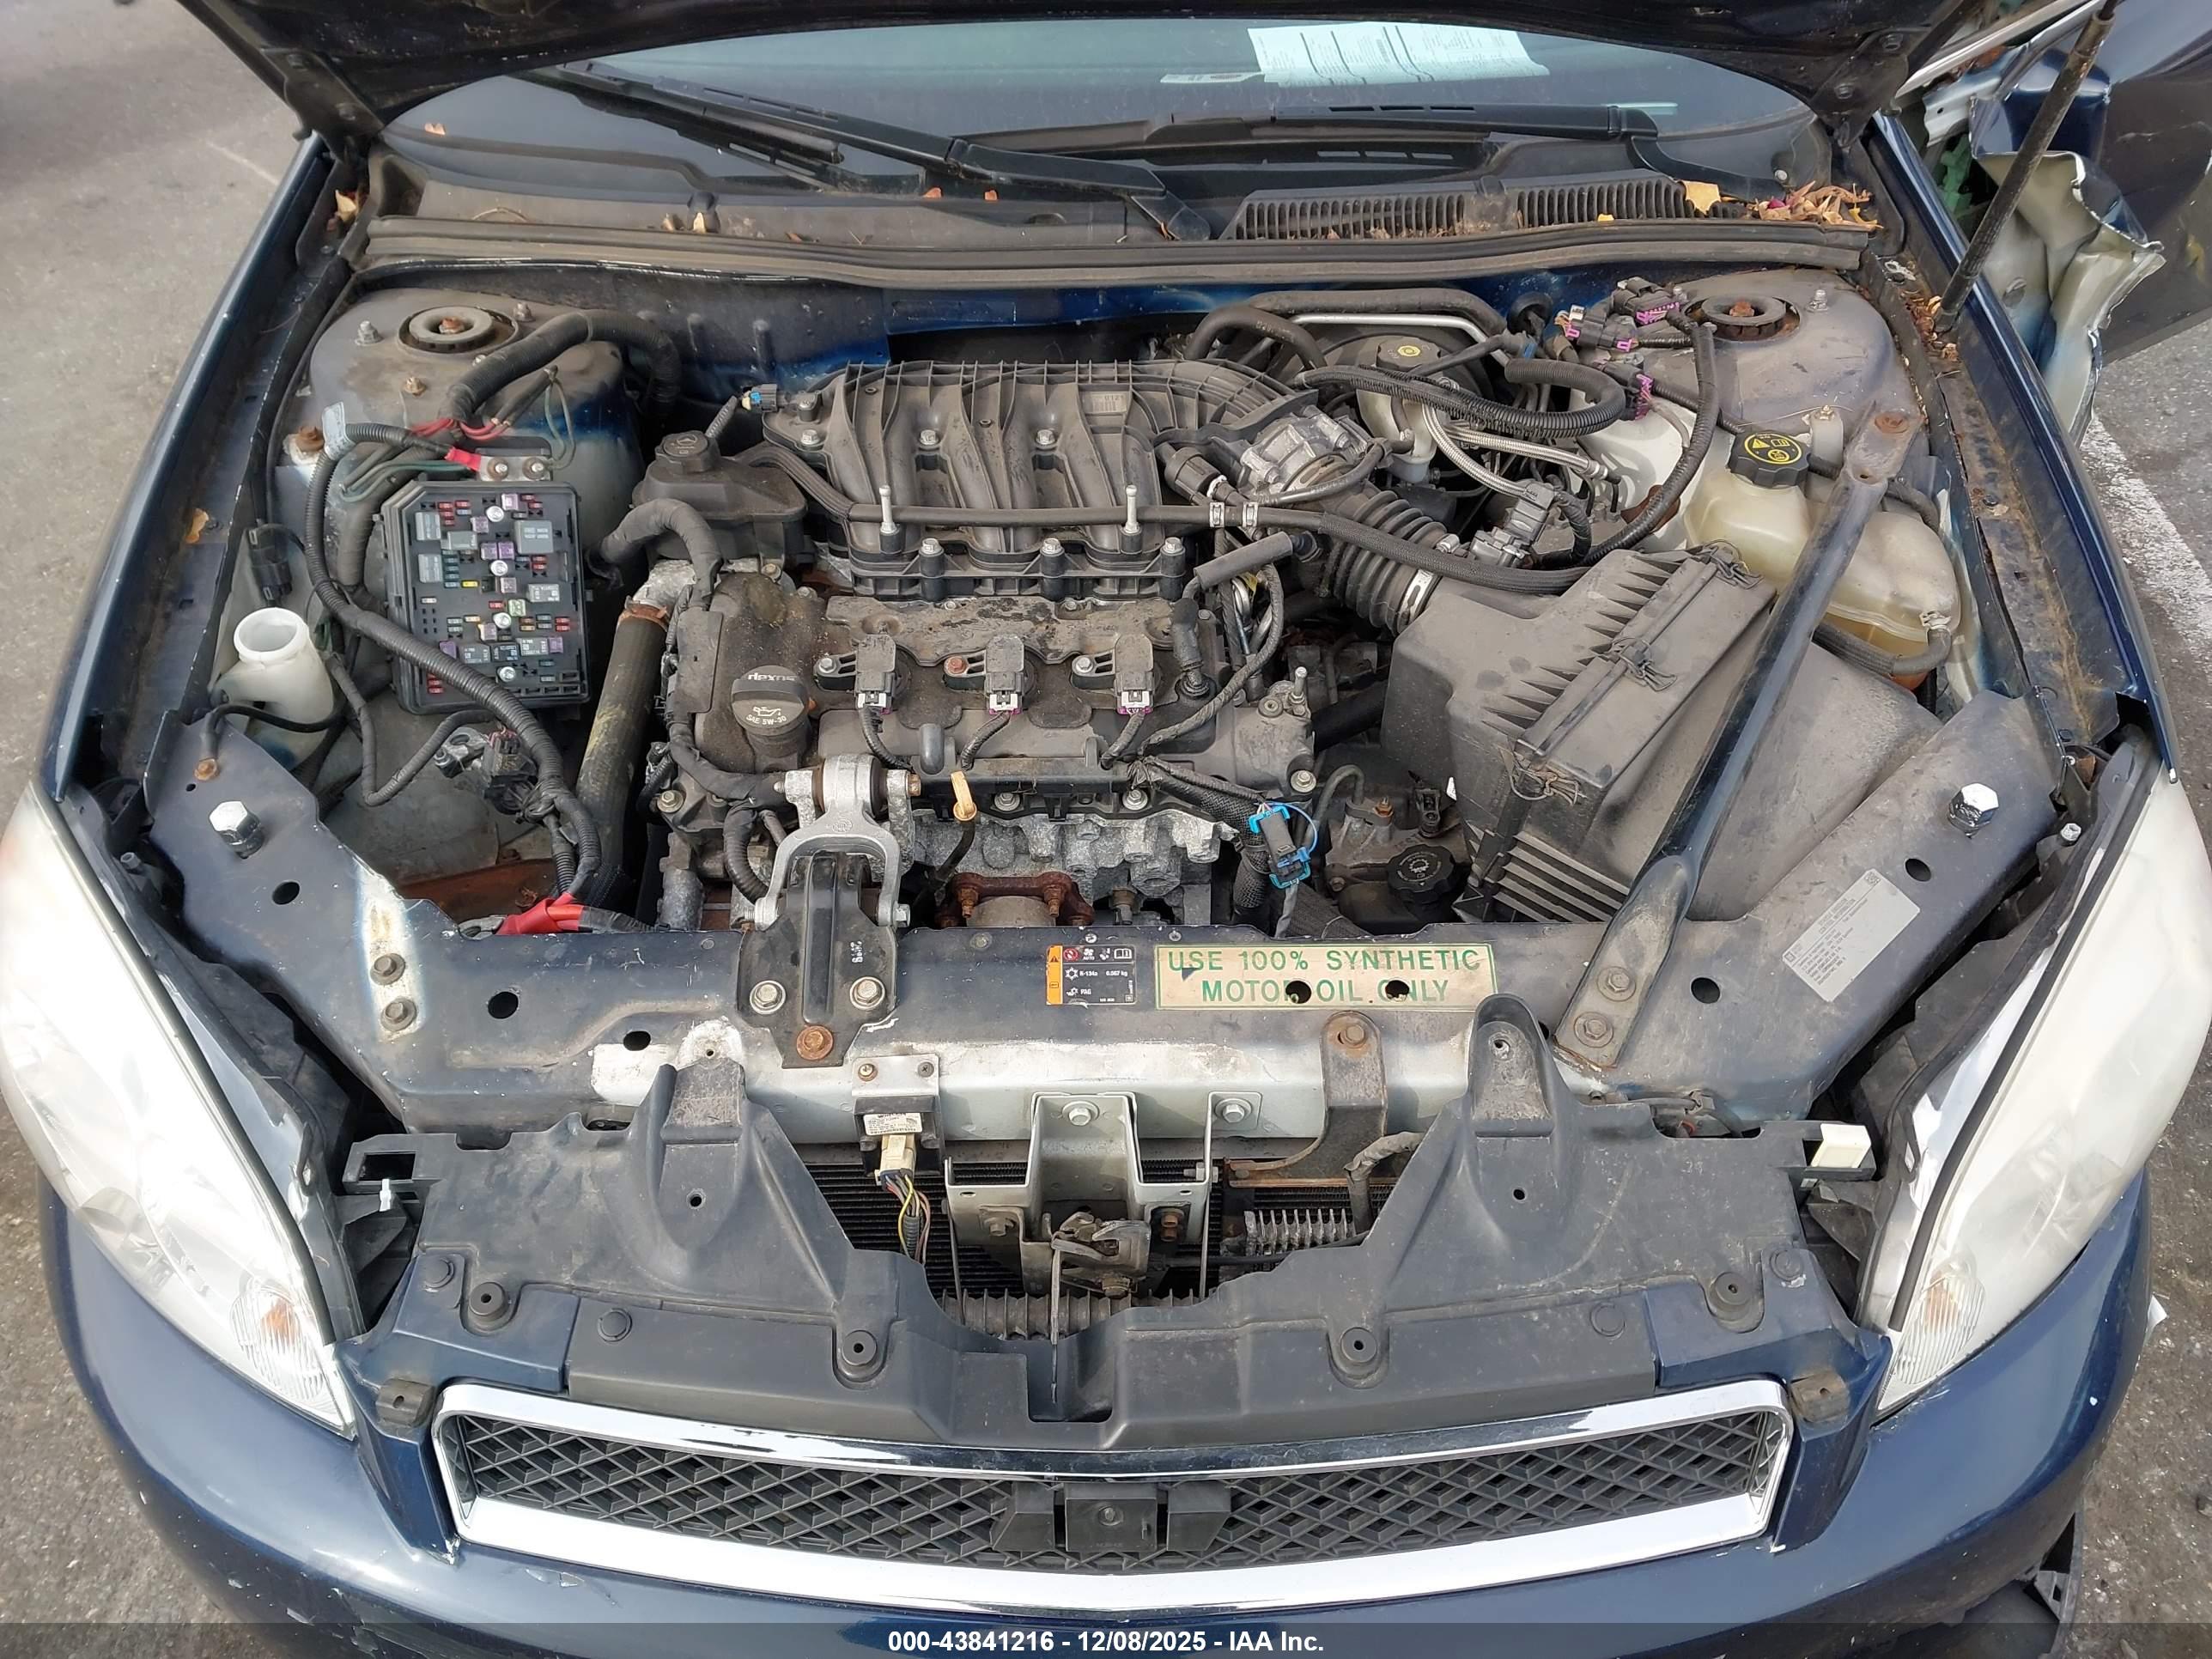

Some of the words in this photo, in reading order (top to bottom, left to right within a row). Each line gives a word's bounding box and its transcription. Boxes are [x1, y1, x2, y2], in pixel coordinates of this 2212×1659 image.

[745, 714, 761, 724] SAE
[762, 715, 787, 726] 5W-30
[1168, 951, 1223, 971] USE
[1238, 950, 1309, 970] 100%
[1326, 950, 1480, 970] SYNTHETIC
[1316, 979, 1363, 1002] OIL
